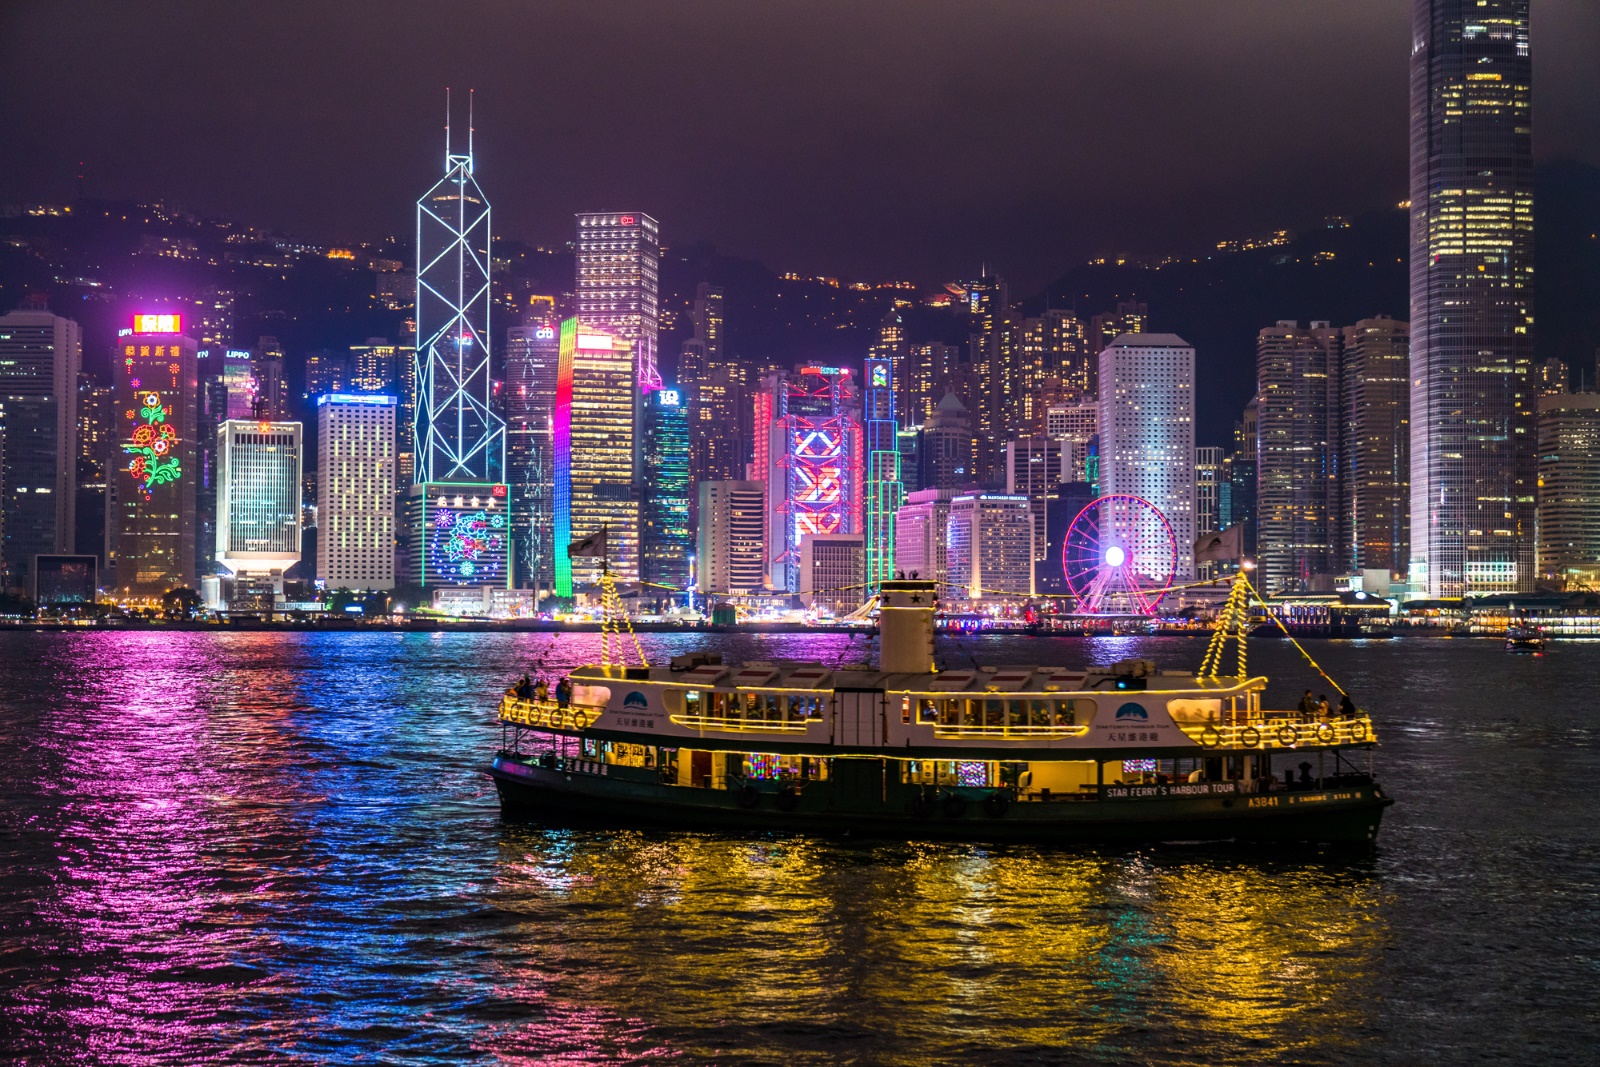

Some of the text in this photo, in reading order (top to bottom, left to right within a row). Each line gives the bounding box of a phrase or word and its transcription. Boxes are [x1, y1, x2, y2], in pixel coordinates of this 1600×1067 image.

[226, 350, 250, 359] LIPPO
[820, 367, 839, 375] HSBC
[1107, 784, 1235, 798] STAR FERRY'S HARBOUR TOUR
[1248, 797, 1279, 808] A3841
